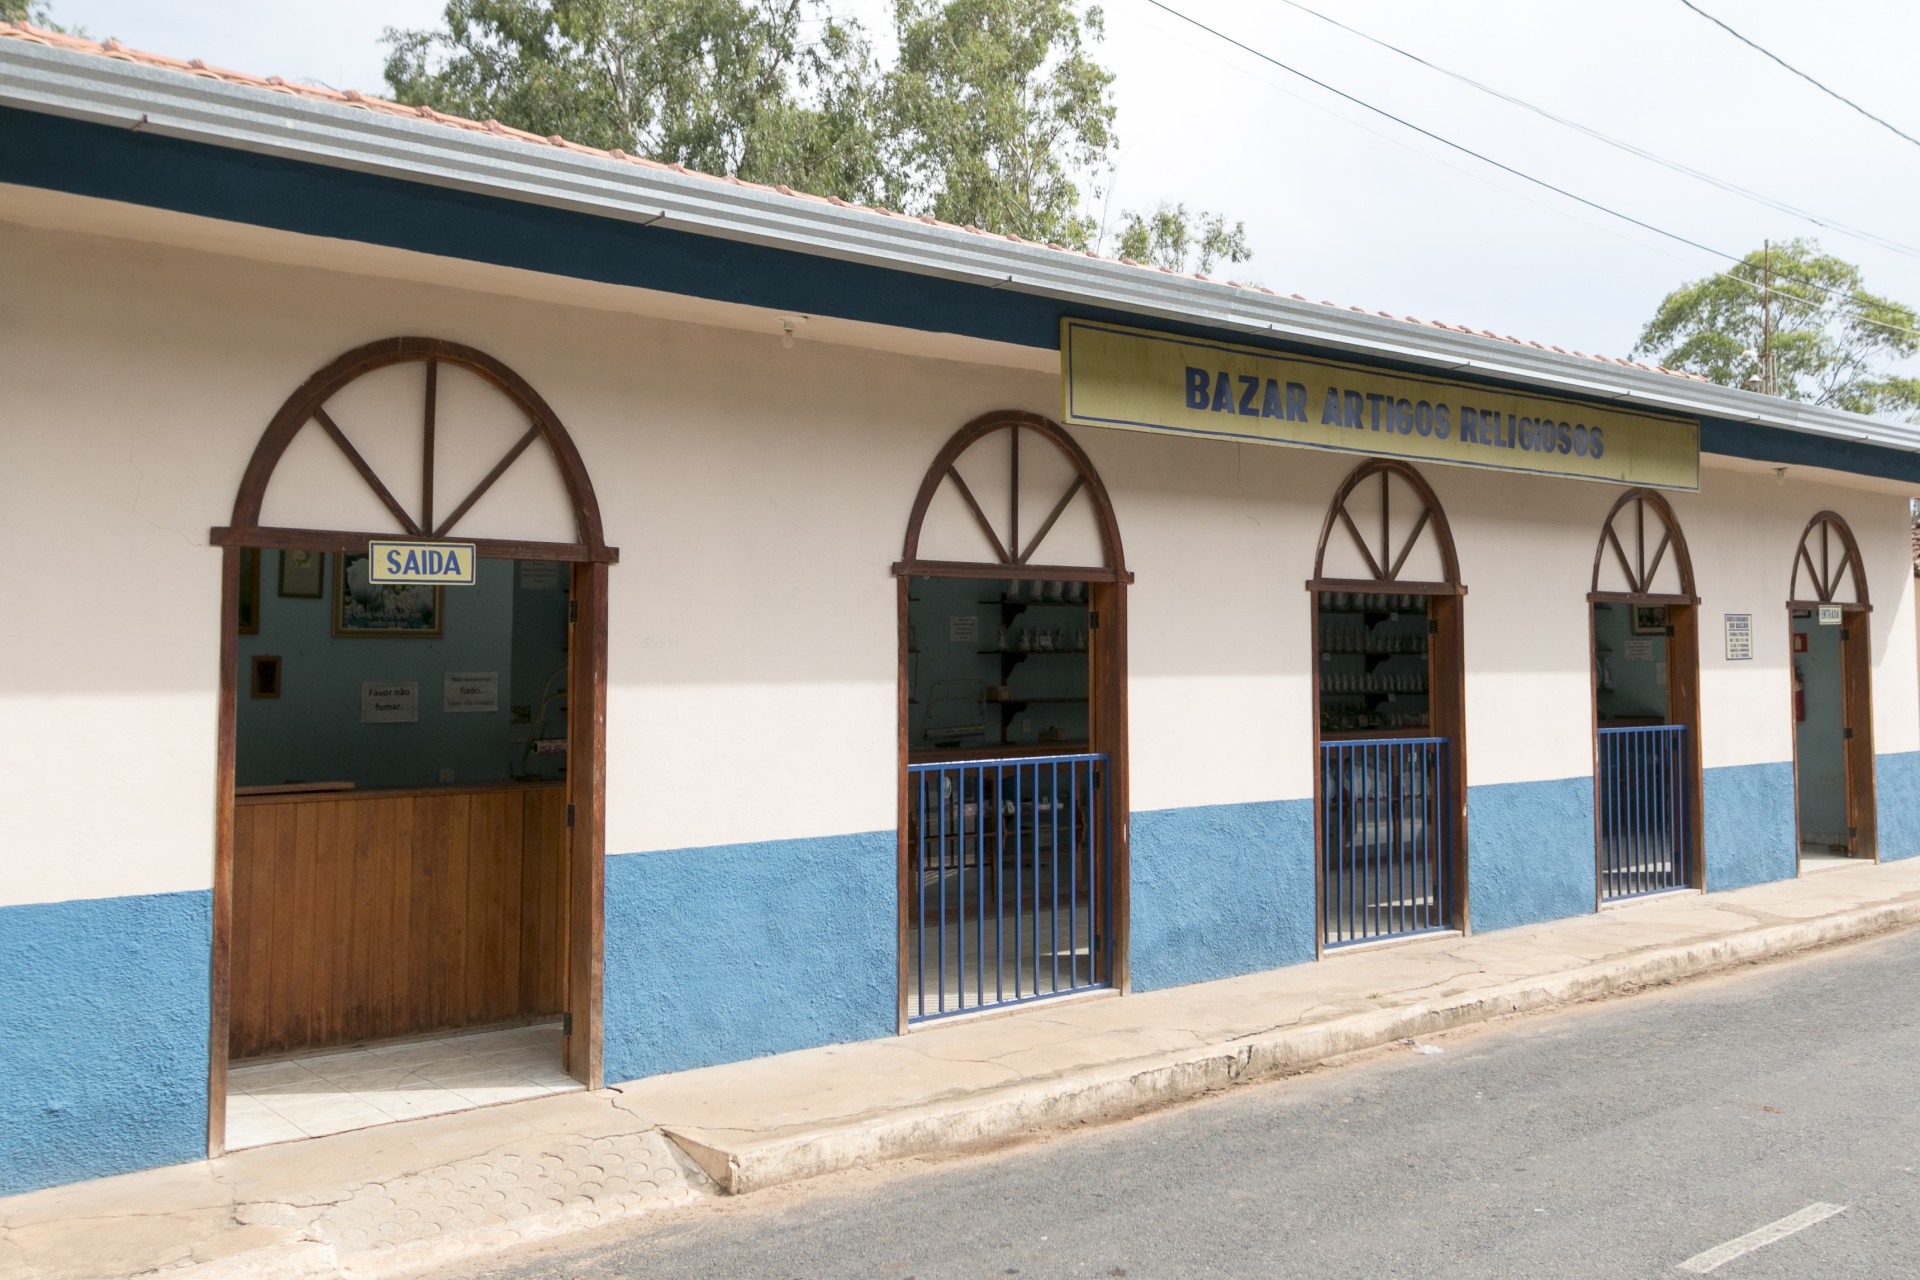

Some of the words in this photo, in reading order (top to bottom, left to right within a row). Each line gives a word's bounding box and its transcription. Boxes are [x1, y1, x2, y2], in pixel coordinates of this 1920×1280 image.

[1186, 366, 1308, 422] BAZAR
[1321, 387, 1450, 439] ARTIGOS
[1460, 406, 1604, 459] RELIGIOSOS
[386, 549, 461, 575] SAIDA
[1821, 608, 1840, 620] ENTRADA
[368, 687, 393, 697] Favor
[394, 687, 411, 697] não
[375, 702, 404, 712] fumar.
